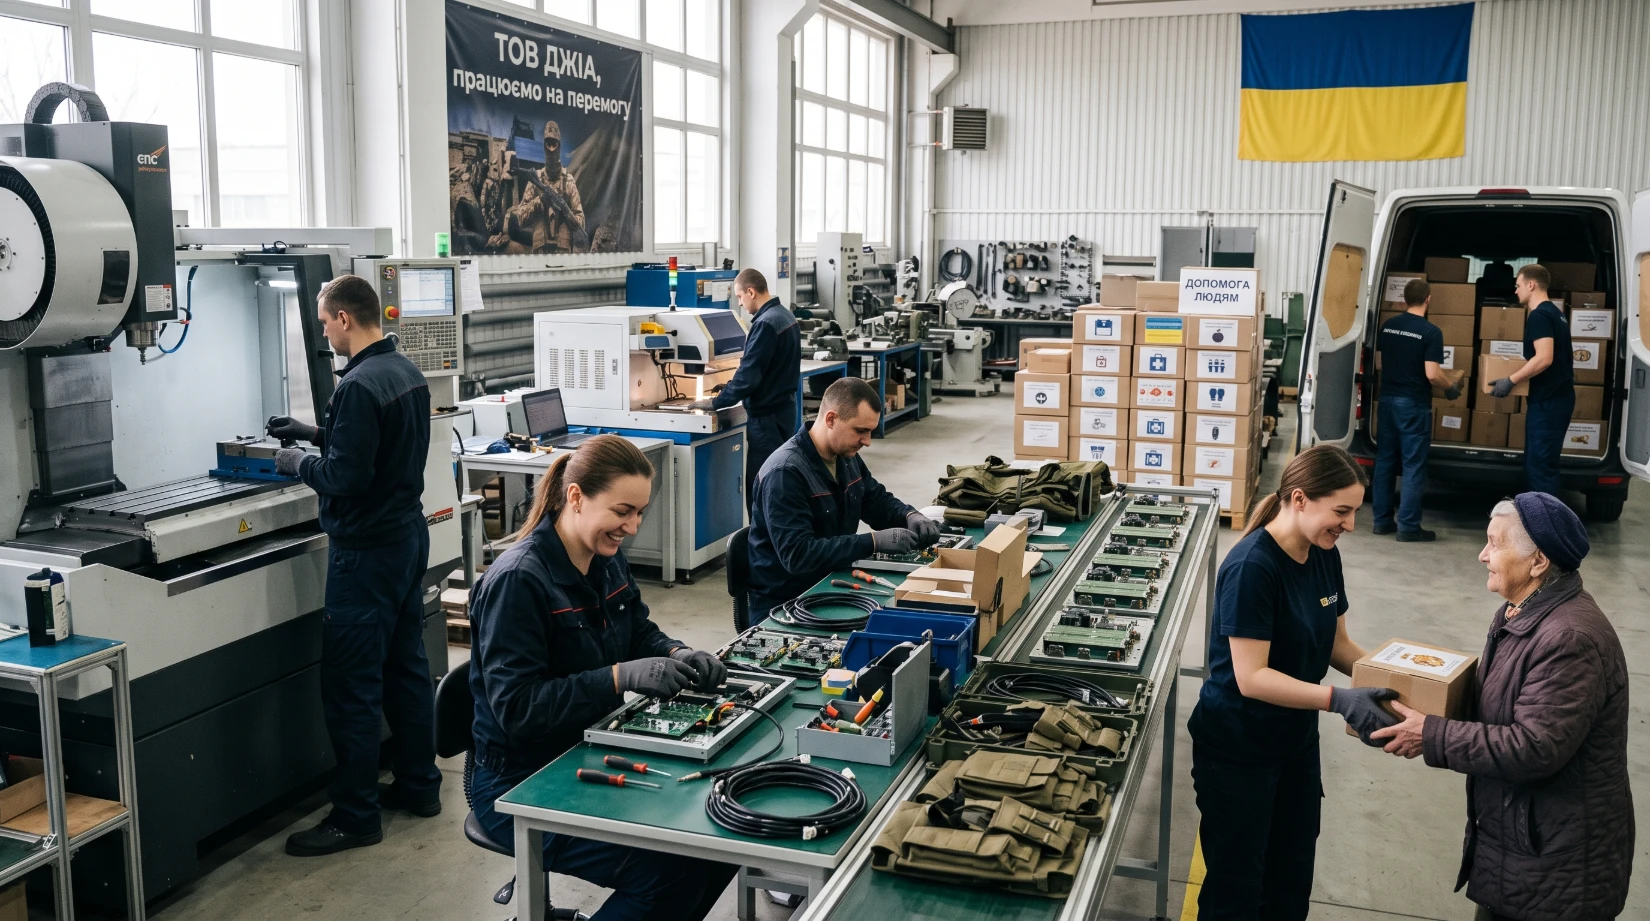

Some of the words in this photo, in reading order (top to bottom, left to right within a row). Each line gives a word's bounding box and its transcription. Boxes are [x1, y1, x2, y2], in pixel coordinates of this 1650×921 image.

[494, 31, 539, 69] ТОВ
[544, 44, 602, 88] ДЖІА,
[453, 68, 542, 101] працюємо
[546, 86, 564, 106] на
[567, 90, 631, 121] перемогу
[1185, 278, 1250, 290] ДОПОМОГА
[1194, 292, 1239, 304] ЛЮДЯМ
